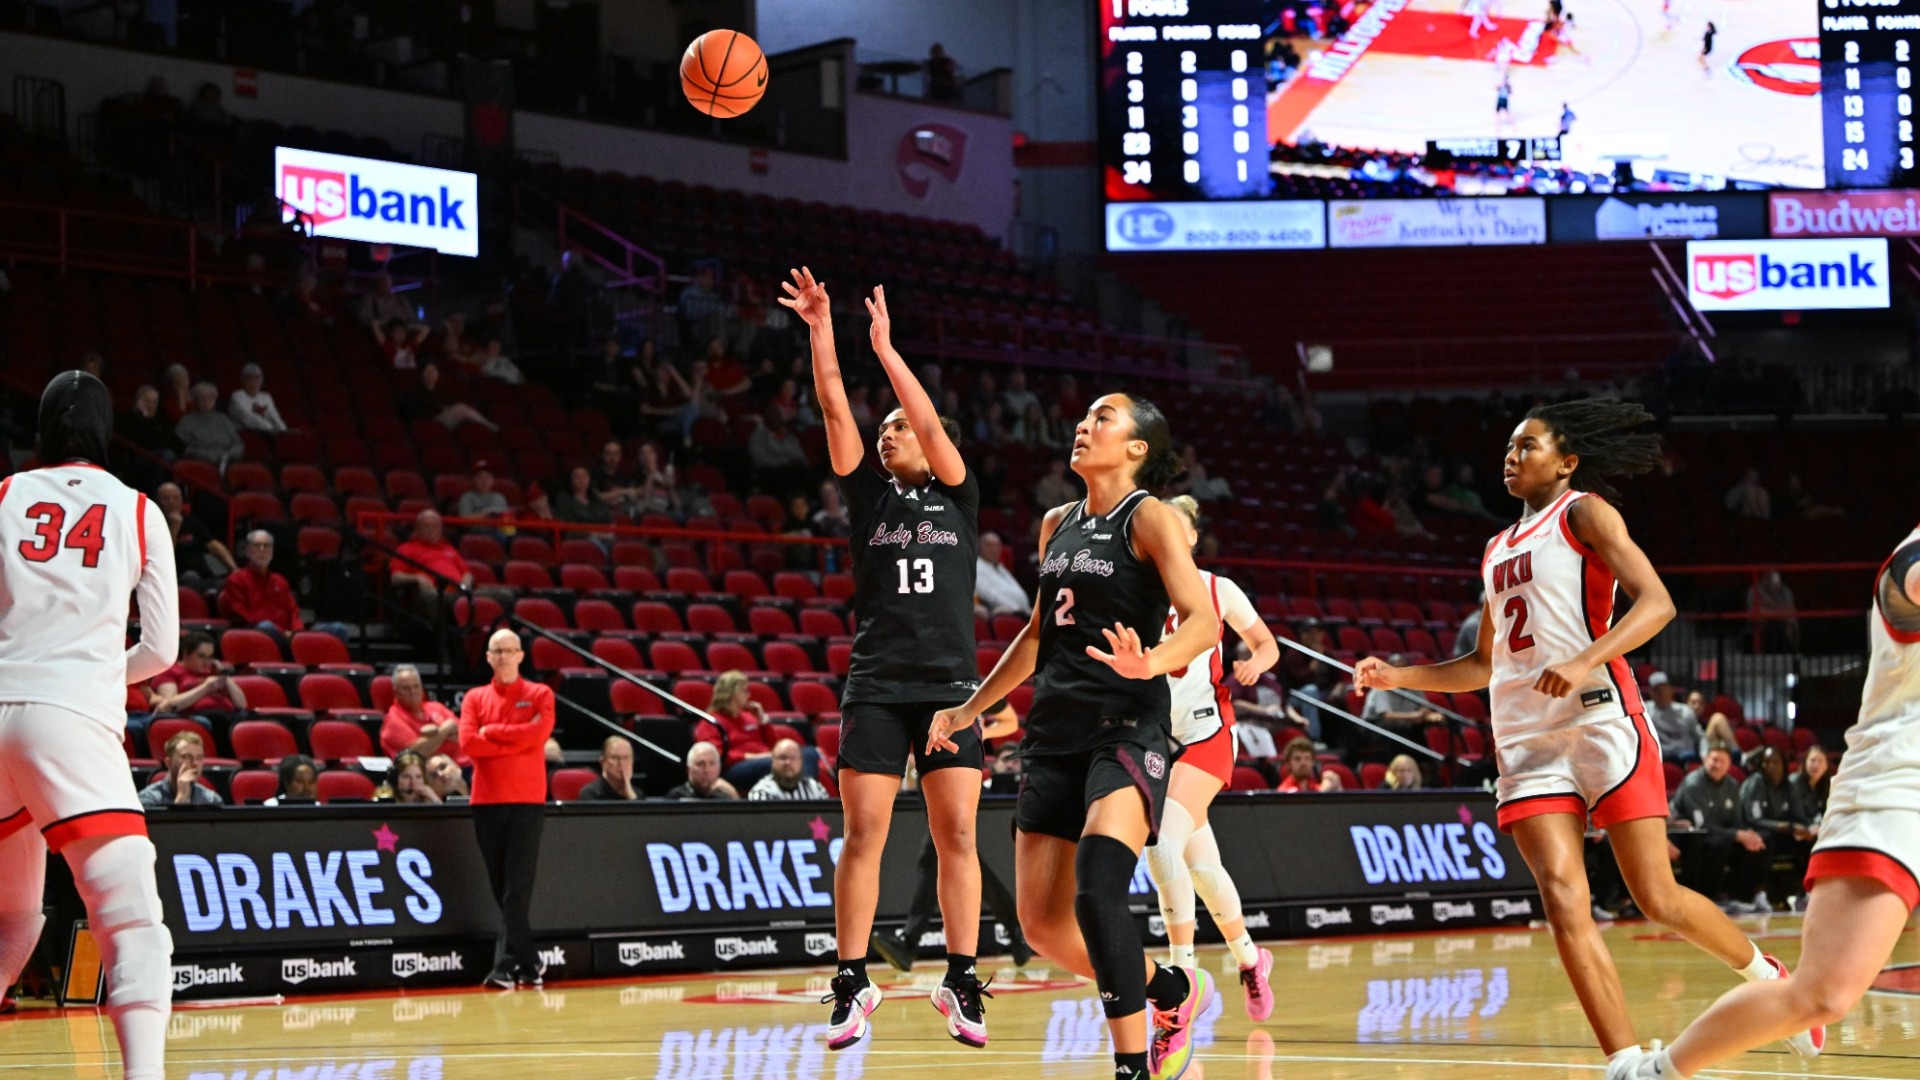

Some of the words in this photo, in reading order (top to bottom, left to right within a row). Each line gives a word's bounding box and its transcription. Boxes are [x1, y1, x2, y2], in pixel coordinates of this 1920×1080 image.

[1823, 16, 1869, 31] PLAYER
[1127, 51, 1143, 74] 2
[1181, 50, 1197, 73] 2
[1231, 50, 1247, 72] 0
[1845, 41, 1859, 63] 2
[1895, 40, 1909, 61] 2
[1127, 79, 1144, 102] 3
[1181, 78, 1198, 101] 0
[1232, 78, 1248, 100] 0
[1845, 67, 1860, 90] 11
[1897, 67, 1911, 88] 0
[1182, 105, 1198, 128] 3
[1233, 104, 1248, 127] 0
[1844, 95, 1864, 117] 13
[1898, 94, 1912, 115] 0
[1183, 131, 1199, 154] 0
[1233, 130, 1249, 153] 0
[1845, 121, 1865, 143] 15
[1899, 120, 1912, 141] 2
[1842, 148, 1869, 170] 24
[1900, 147, 1914, 169] 3
[1123, 160, 1152, 184] 34
[1184, 160, 1200, 183] 0
[1237, 159, 1247, 182] 1
[18, 501, 107, 568] 34
[869, 522, 912, 549] Lady
[917, 521, 958, 546] Bears
[1071, 548, 1114, 577] Bears
[1493, 551, 1533, 594] WKU
[897, 558, 934, 594] 13
[1055, 587, 1076, 627] 2
[1504, 595, 1536, 653] 2
